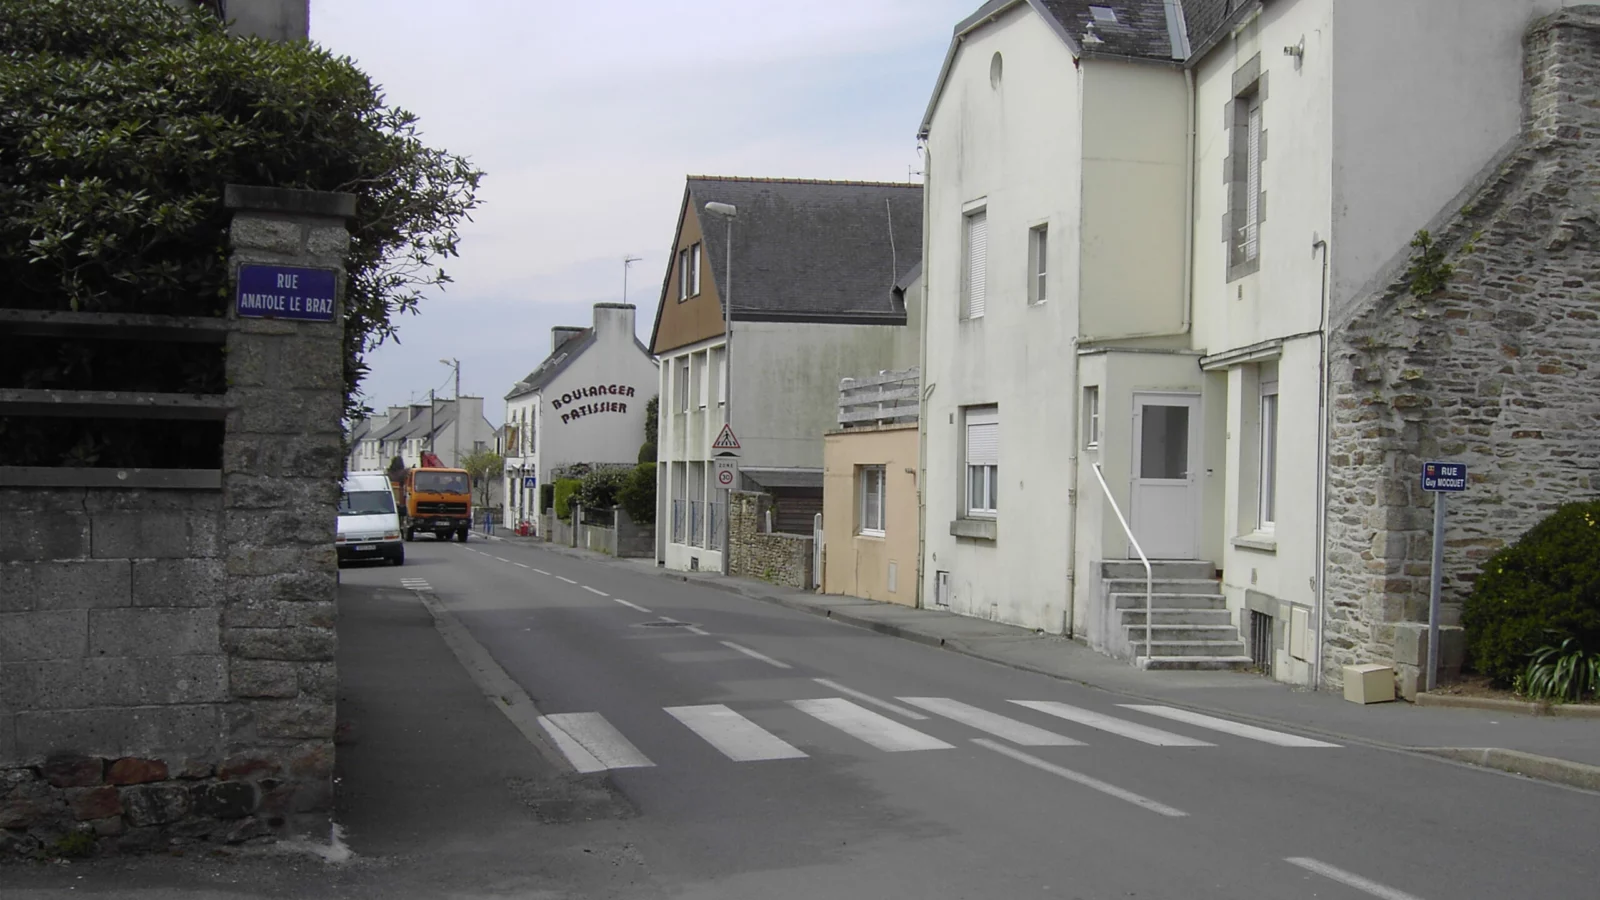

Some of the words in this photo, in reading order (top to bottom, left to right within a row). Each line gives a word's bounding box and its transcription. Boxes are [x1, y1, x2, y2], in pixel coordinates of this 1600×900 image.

[277, 273, 299, 289] RUE
[241, 293, 285, 310] ANATOLE
[289, 296, 302, 312] LE
[305, 298, 333, 314] BRAZ
[551, 384, 635, 410] BOULANGER
[561, 401, 627, 425] PATISSIER
[1441, 466, 1458, 476] RUE
[1425, 477, 1436, 488] Guy
